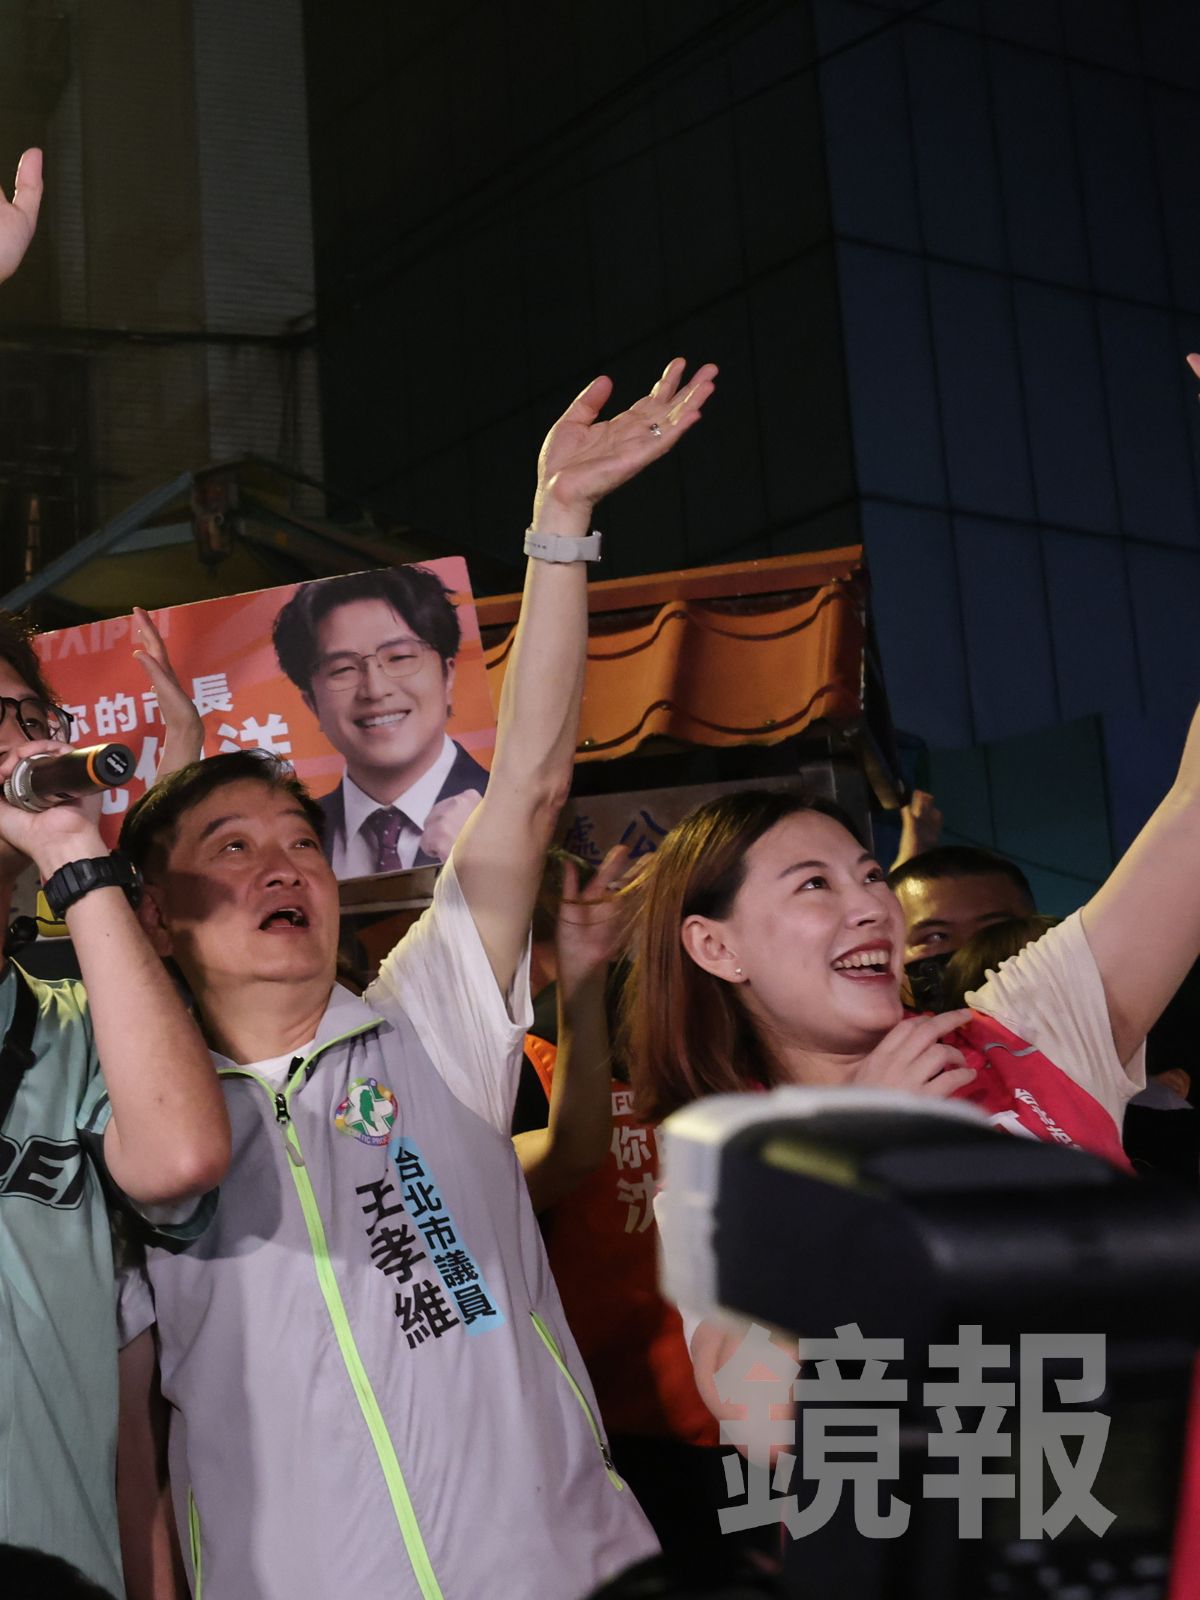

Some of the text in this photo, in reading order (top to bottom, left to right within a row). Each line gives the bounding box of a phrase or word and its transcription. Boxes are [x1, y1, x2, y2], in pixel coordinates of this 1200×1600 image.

[355, 1168, 460, 1350] 王孝維
[394, 1146, 497, 1326] 台北市議員
